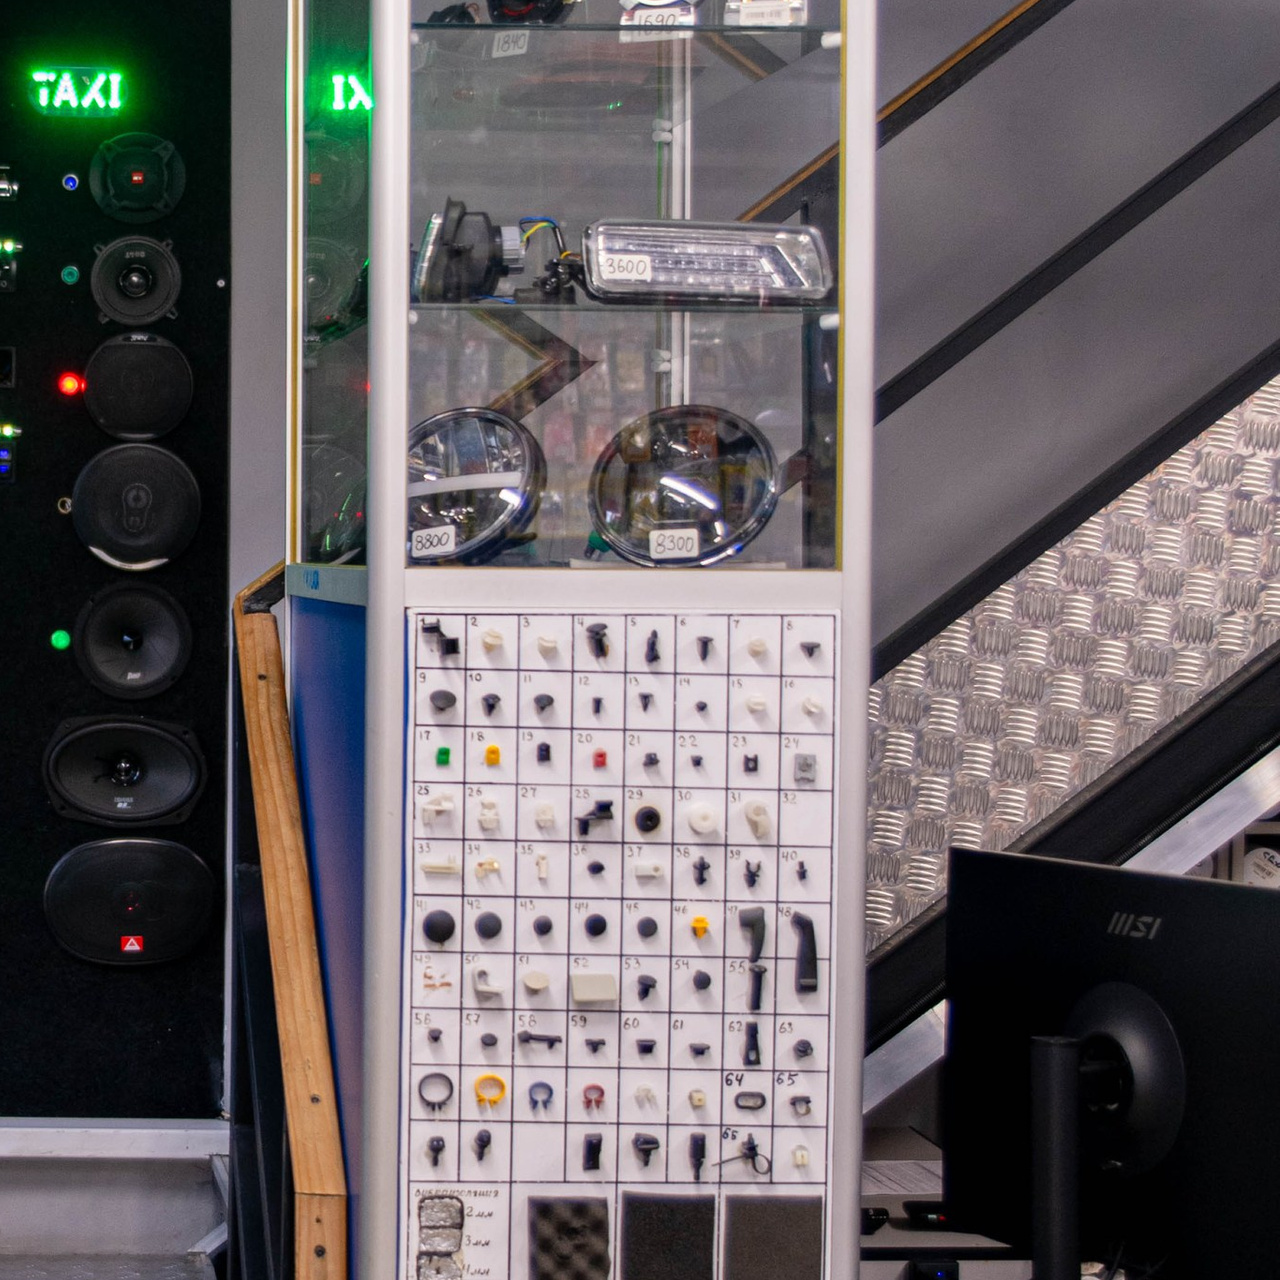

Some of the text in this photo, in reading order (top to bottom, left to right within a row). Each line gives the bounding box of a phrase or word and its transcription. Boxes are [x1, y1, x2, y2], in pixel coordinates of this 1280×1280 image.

[637, 13, 677, 37] 1690
[495, 31, 527, 53] 1840
[32, 71, 122, 108] TAXI
[606, 257, 648, 276] 3600
[414, 530, 451, 550] 8800
[655, 534, 694, 553] 8300
[472, 618, 478, 627] 2
[523, 618, 530, 627] 3
[733, 620, 740, 628] 7
[787, 620, 793, 630] 8
[420, 673, 426, 683] 9
[469, 673, 481, 682] 10
[579, 677, 590, 685] 12
[629, 677, 639, 685] 13
[732, 678, 742, 687] 15
[785, 679, 795, 688] 16
[419, 731, 430, 740] 17
[471, 732, 484, 741] 18
[522, 731, 533, 741] 19
[578, 733, 592, 743] 20
[629, 735, 640, 745] 21
[679, 736, 698, 746] 22
[733, 736, 747, 747] 23
[784, 738, 799, 748] 24
[417, 786, 429, 795] 25
[468, 787, 482, 796] 26
[521, 788, 537, 798] 27
[628, 789, 643, 799] 29
[678, 791, 691, 800] 30
[730, 792, 741, 802] 31
[782, 793, 796, 804] 32
[418, 843, 431, 853] 33
[467, 844, 480, 853] 34
[520, 844, 533, 854] 35
[574, 845, 587, 855] 36
[628, 846, 643, 857] 37
[676, 847, 690, 857] 38
[729, 849, 740, 859] 39
[782, 851, 797, 861] 40
[467, 900, 481, 909] 42
[520, 901, 535, 910] 43
[575, 902, 588, 912] 44
[674, 905, 687, 914] 46
[778, 907, 792, 916] 48
[518, 955, 529, 964] 51
[574, 958, 588, 968] 52
[624, 960, 640, 969] 53
[674, 960, 689, 969] 54
[729, 961, 745, 973] 55
[465, 1014, 480, 1024] 57
[519, 1016, 536, 1026] 58
[571, 1015, 587, 1027] 59
[623, 1018, 639, 1030] 60
[673, 1020, 683, 1030] 61
[728, 1021, 743, 1031] 62
[779, 1021, 793, 1034] 63
[725, 1073, 744, 1086] 64
[776, 1073, 798, 1085] 65
